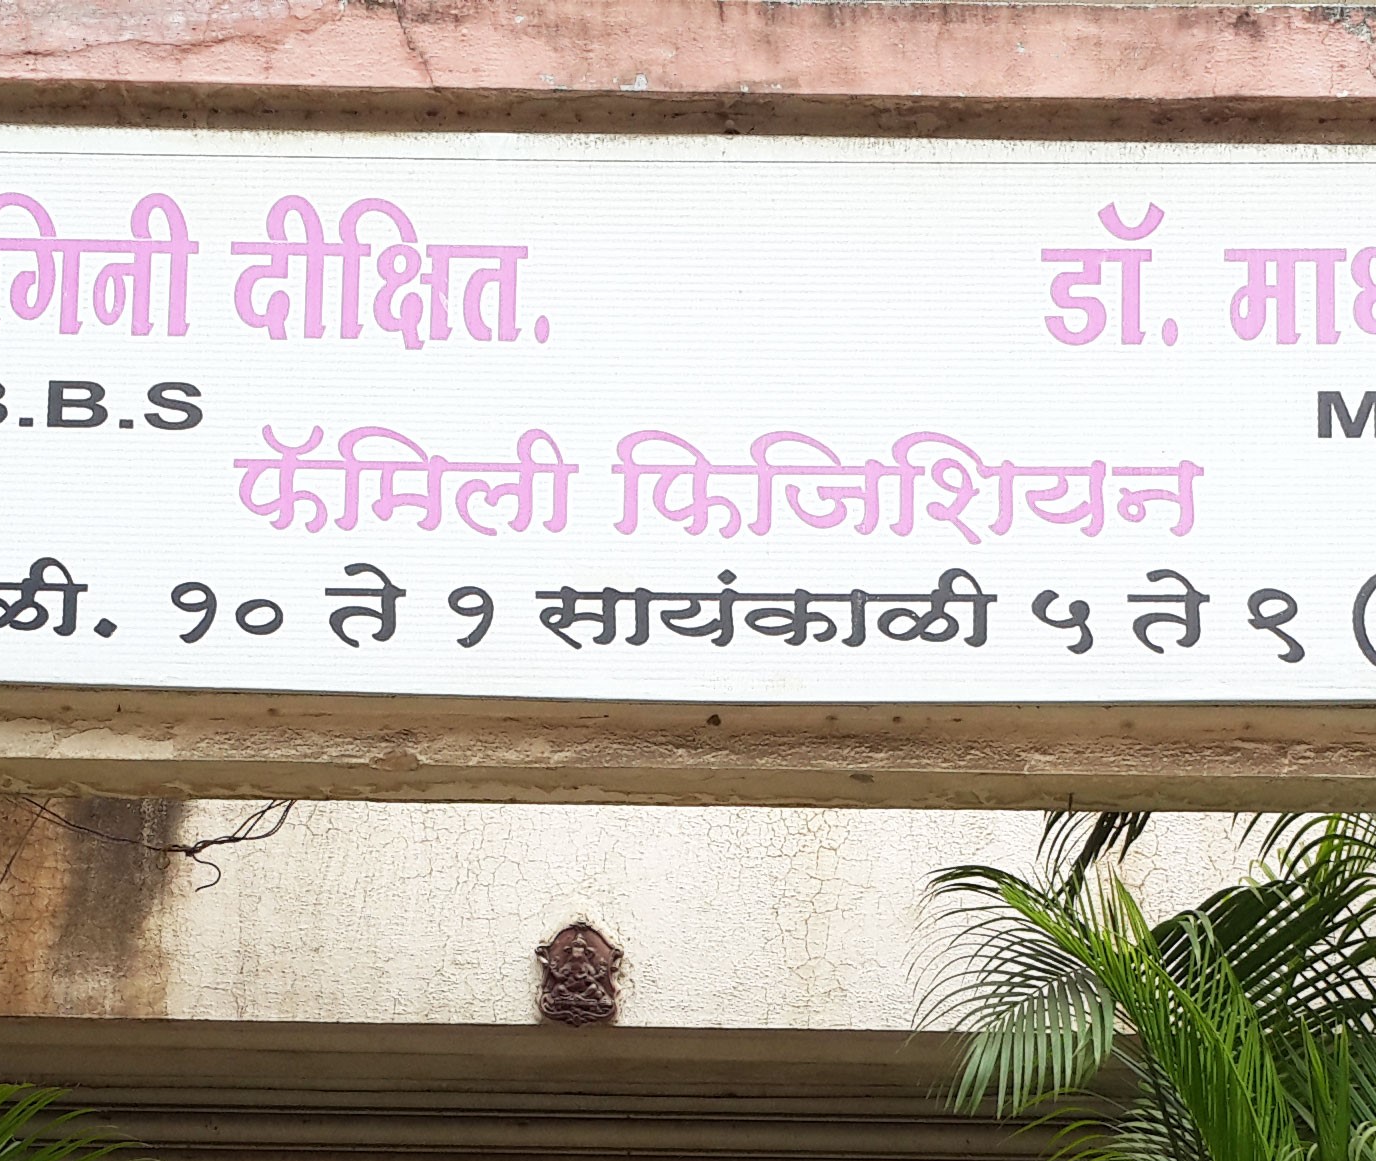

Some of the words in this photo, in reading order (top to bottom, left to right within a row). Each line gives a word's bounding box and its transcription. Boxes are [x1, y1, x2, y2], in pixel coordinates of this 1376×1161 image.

[230, 194, 550, 350] दीक्षित.
[1041, 202, 1178, 346] डॉ.
[234, 424, 580, 536] फॅमिली
[611, 429, 1206, 545] फिजिशियन
[170, 581, 284, 645] १०
[324, 562, 408, 648] ते
[447, 585, 494, 648] १
[535, 568, 998, 650] सायंकाळी
[1031, 589, 1094, 655] ५
[1127, 569, 1210, 654] ते
[1246, 588, 1306, 664] ९
